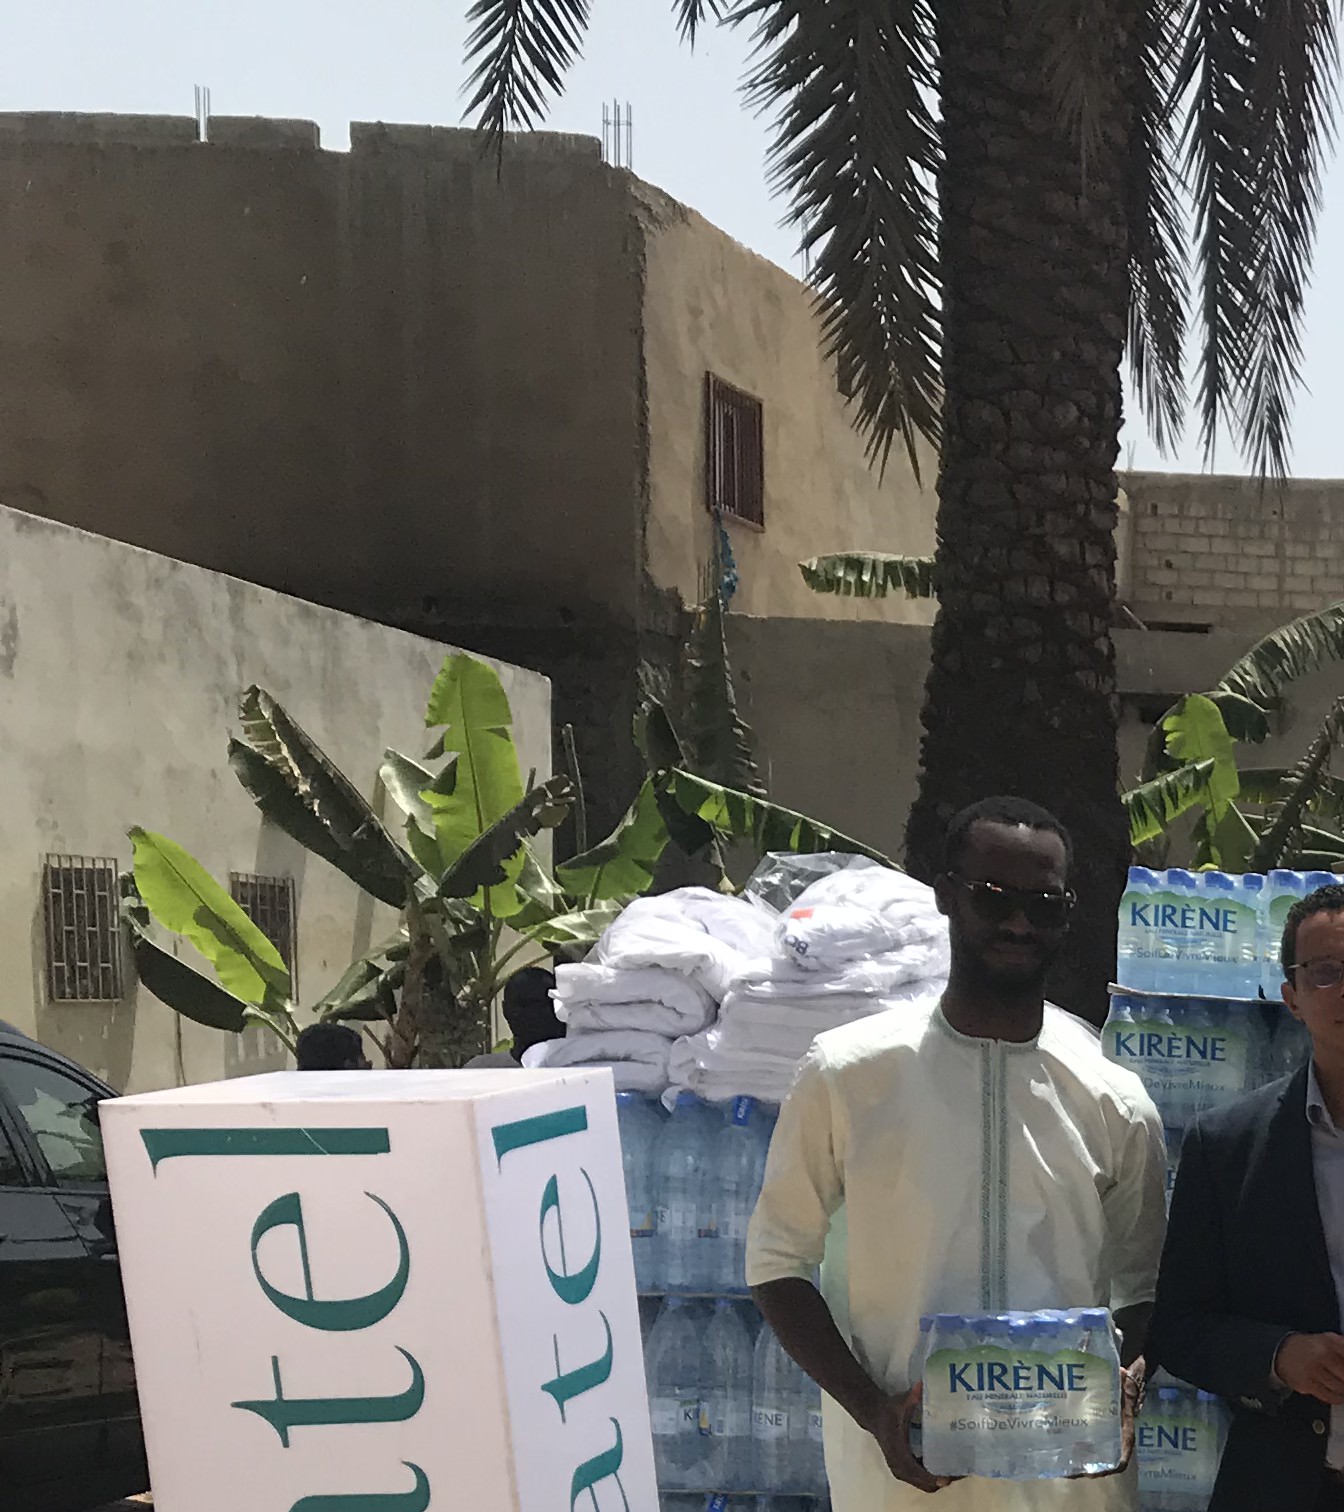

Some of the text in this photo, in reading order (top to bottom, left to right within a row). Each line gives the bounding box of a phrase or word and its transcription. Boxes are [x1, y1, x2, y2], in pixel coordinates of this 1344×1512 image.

[1131, 902, 1237, 933] KIRÈNE
[1115, 1032, 1226, 1062] KIRÈNE
[949, 1360, 1087, 1393] KIRÈNE
